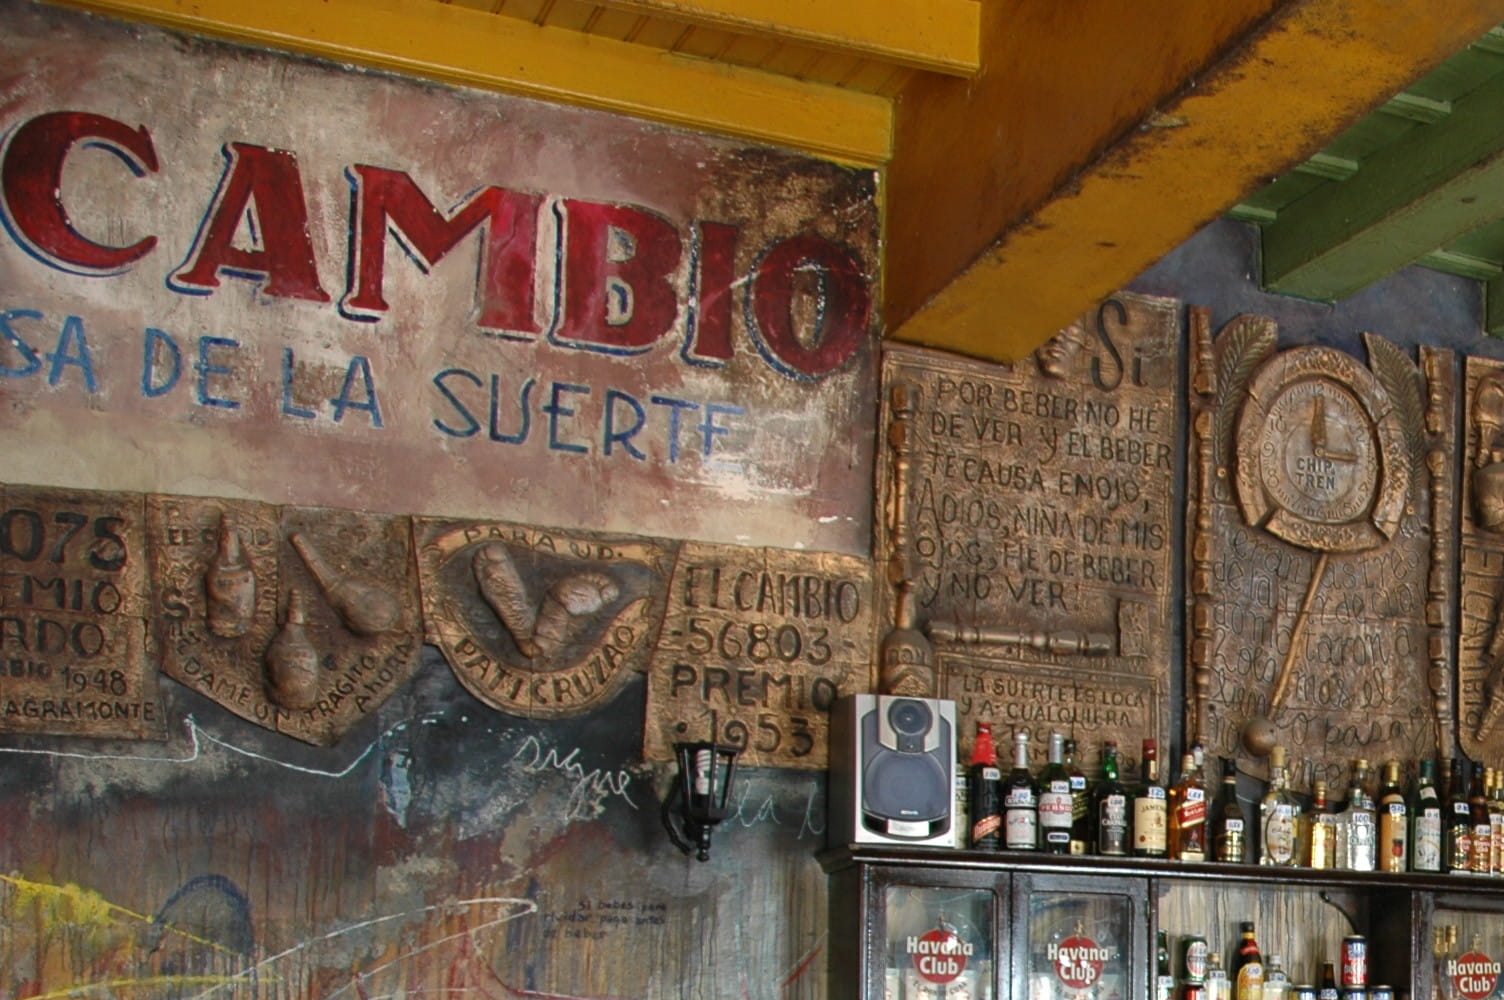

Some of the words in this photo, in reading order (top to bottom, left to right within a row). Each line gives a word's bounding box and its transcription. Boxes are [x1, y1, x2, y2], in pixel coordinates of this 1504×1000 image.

[1, 109, 874, 381] CAMBIO
[142, 327, 240, 410] DE
[281, 346, 385, 429] LA
[431, 366, 747, 471] SUERTE
[936, 377, 994, 409] POR
[1003, 388, 1078, 423] BEBER
[1085, 404, 1121, 429] NO
[1128, 407, 1158, 434] HE
[931, 411, 962, 439] DE
[971, 415, 1024, 447] VER
[1067, 431, 1097, 457] EL
[1100, 437, 1173, 470] BEBER
[962, 456, 1046, 493] CAUSA
[1295, 472, 1336, 490] TREN
[463, 524, 557, 553] PARA
[1082, 515, 1111, 546] DE
[1120, 520, 1165, 551] MIS
[1003, 543, 1039, 573] HE
[1050, 551, 1076, 578] DE
[1082, 551, 1157, 590] BEBER
[685, 566, 722, 610] EL
[733, 569, 860, 625] CAMBIO
[950, 574, 992, 600] NO
[61, 666, 128, 697] 1948
[670, 664, 839, 711] PREMIO
[4, 696, 156, 722] AGRAMONTE
[919, 956, 960, 977] Club
[1047, 942, 1109, 962] Havana
[1448, 959, 1502, 977] Havana
[1459, 975, 1492, 994] Club
